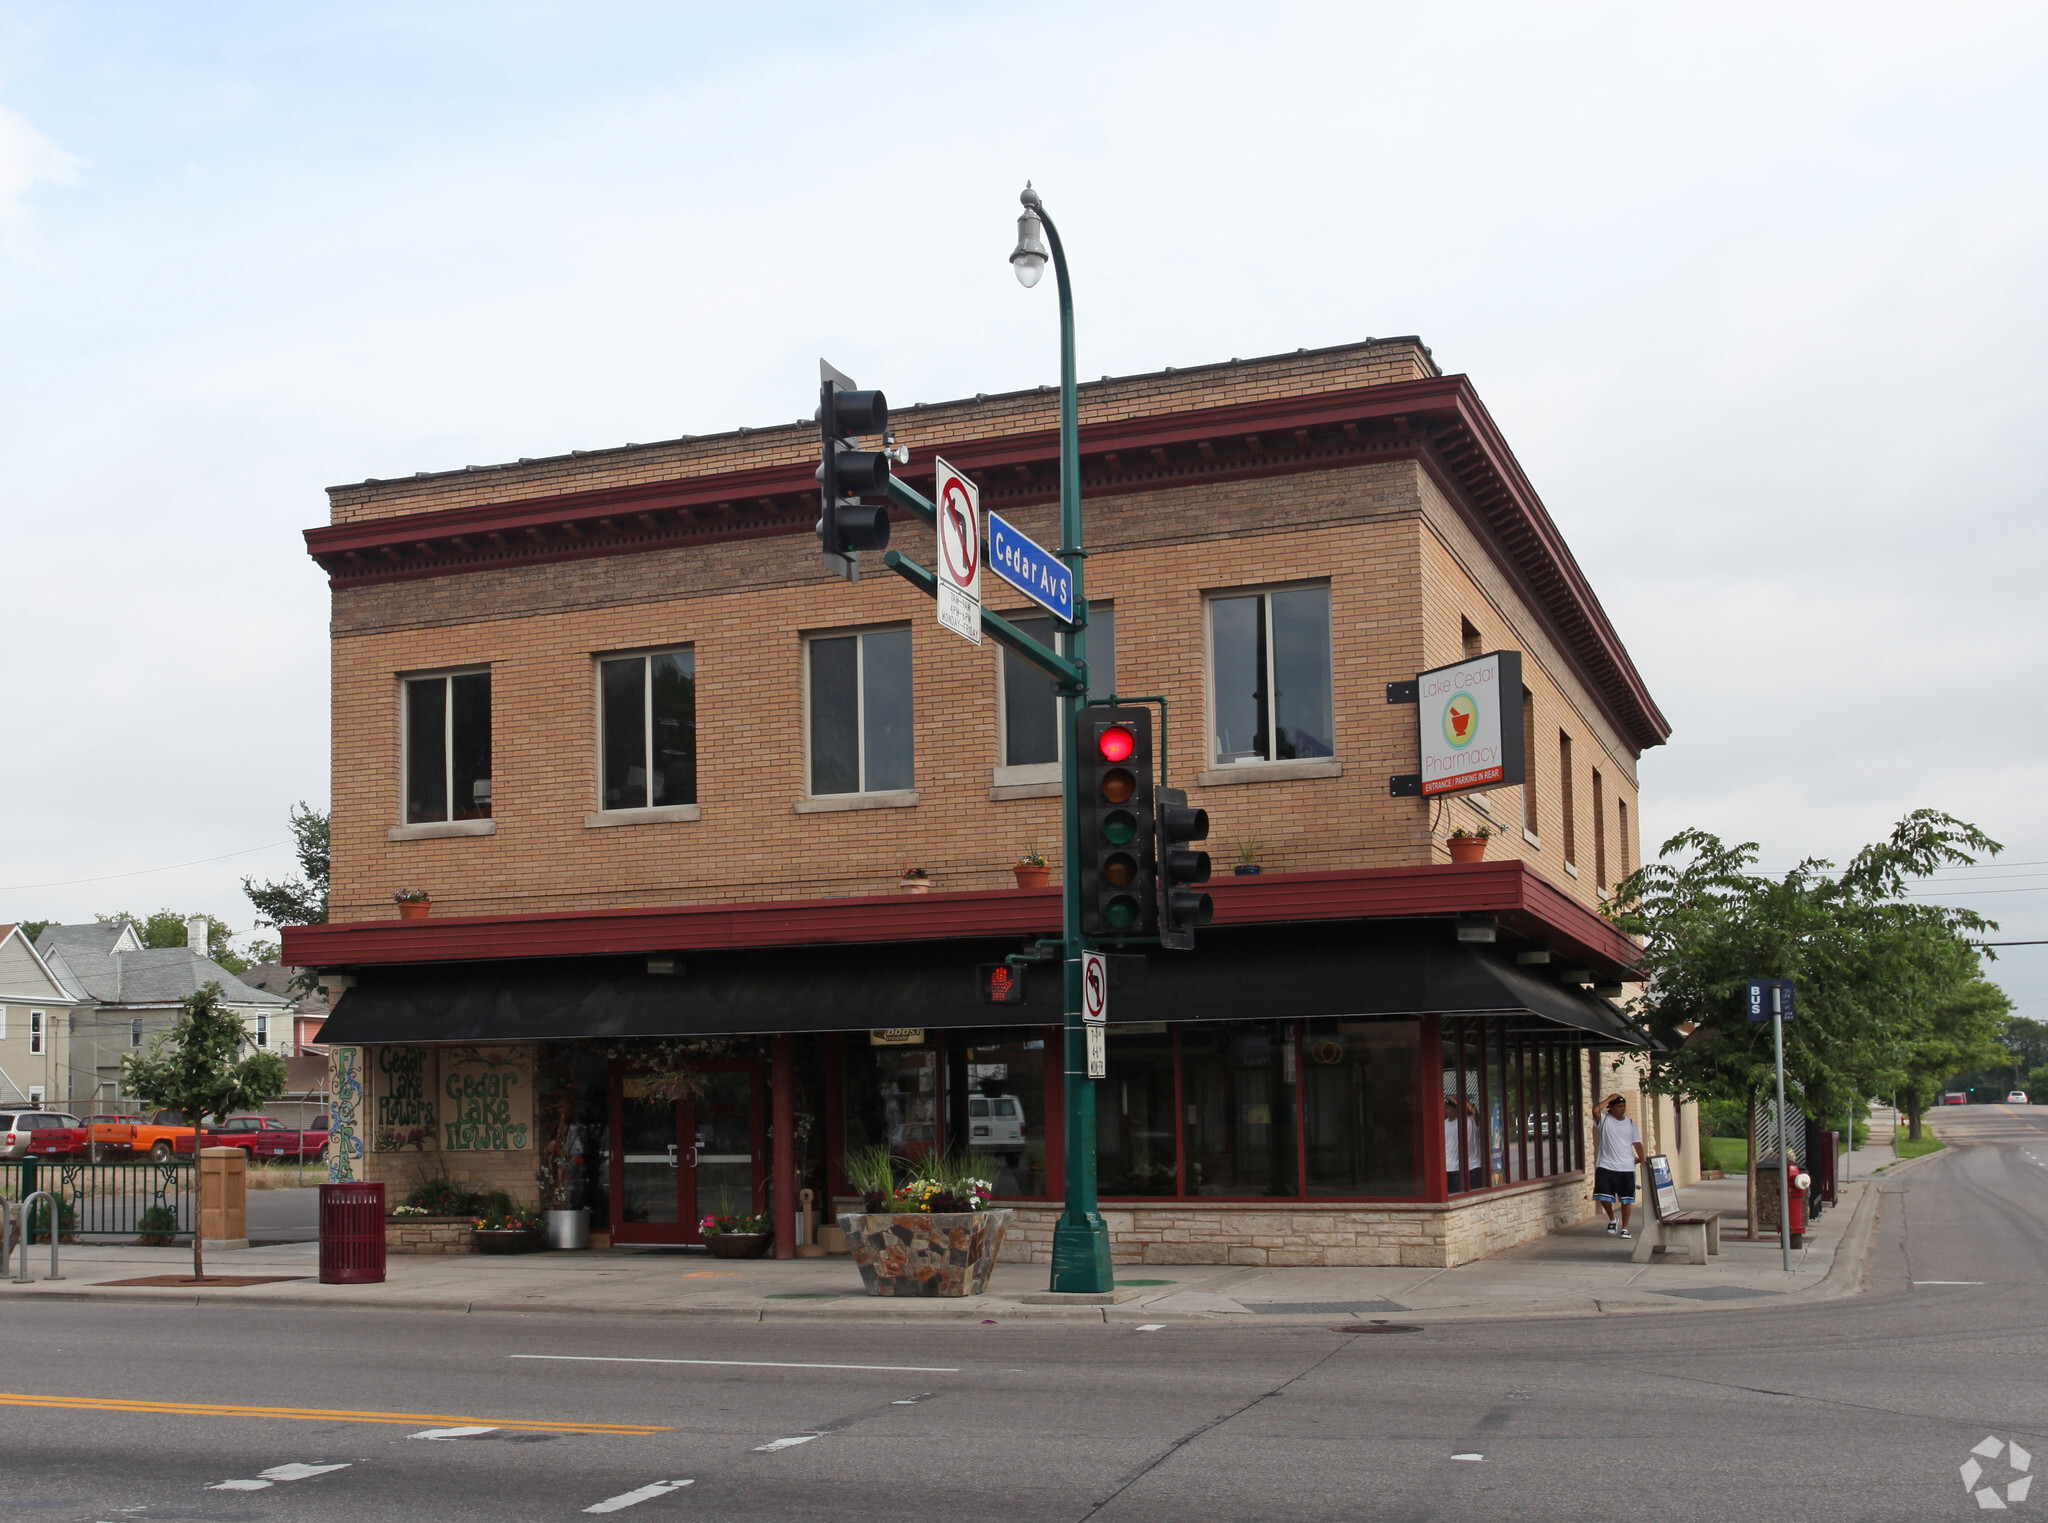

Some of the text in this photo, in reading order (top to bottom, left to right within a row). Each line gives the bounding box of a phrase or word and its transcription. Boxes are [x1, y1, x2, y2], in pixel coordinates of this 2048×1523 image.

[996, 532, 1067, 605] Cedar Av S
[1423, 665, 1495, 698] Lake Cedar
[1425, 745, 1498, 775] Pharmacy
[1425, 779, 1452, 792] ENTRANCE
[1455, 773, 1478, 786] PARKING
[1478, 772, 1484, 780] IN
[1484, 768, 1499, 779] REAR
[1751, 986, 1761, 1014] BUS
[380, 1045, 427, 1073] Cedar
[388, 1072, 423, 1101] Lake
[445, 1072, 519, 1099] Cedar
[337, 1048, 357, 1183] FLORA
[456, 1098, 511, 1124] Lake
